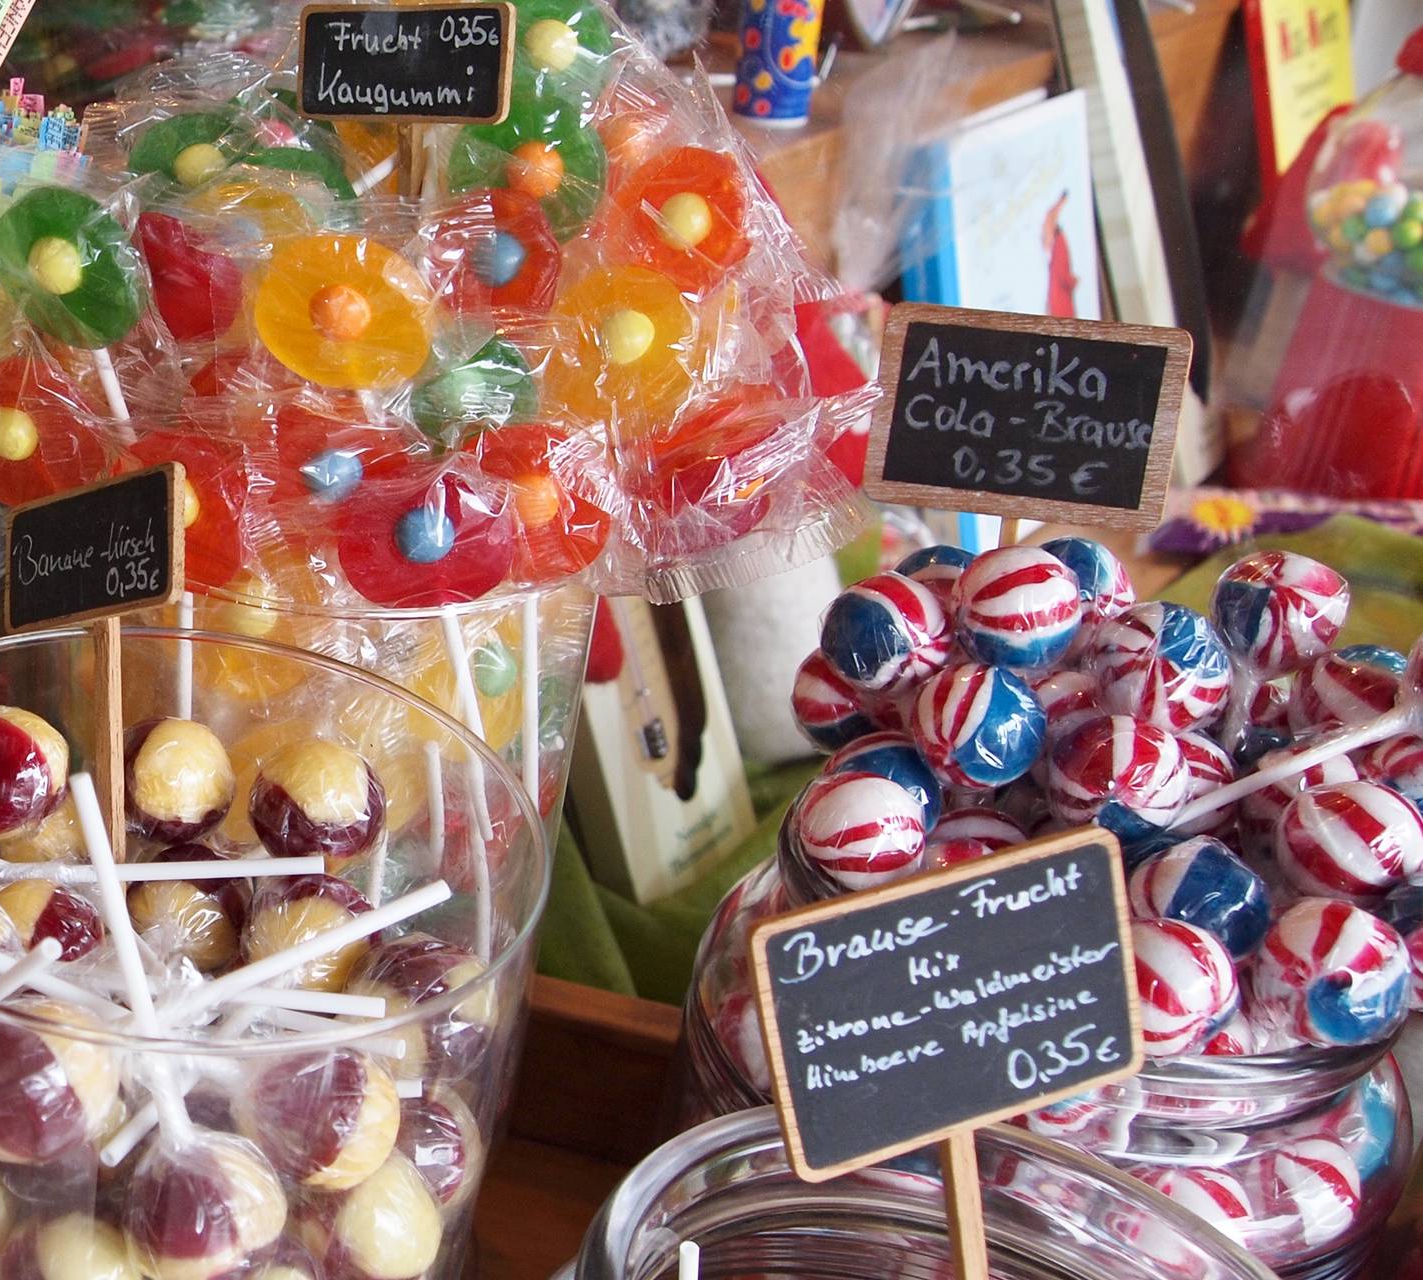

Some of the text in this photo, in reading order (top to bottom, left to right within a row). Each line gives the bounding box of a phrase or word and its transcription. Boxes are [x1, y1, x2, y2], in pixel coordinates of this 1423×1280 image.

[327, 19, 422, 55] Frucht
[318, 62, 475, 113] Kaugummi
[906, 337, 1108, 402] Amerika
[908, 951, 960, 985] Mix
[807, 990, 1098, 1090] Himbeere Apfelsine
